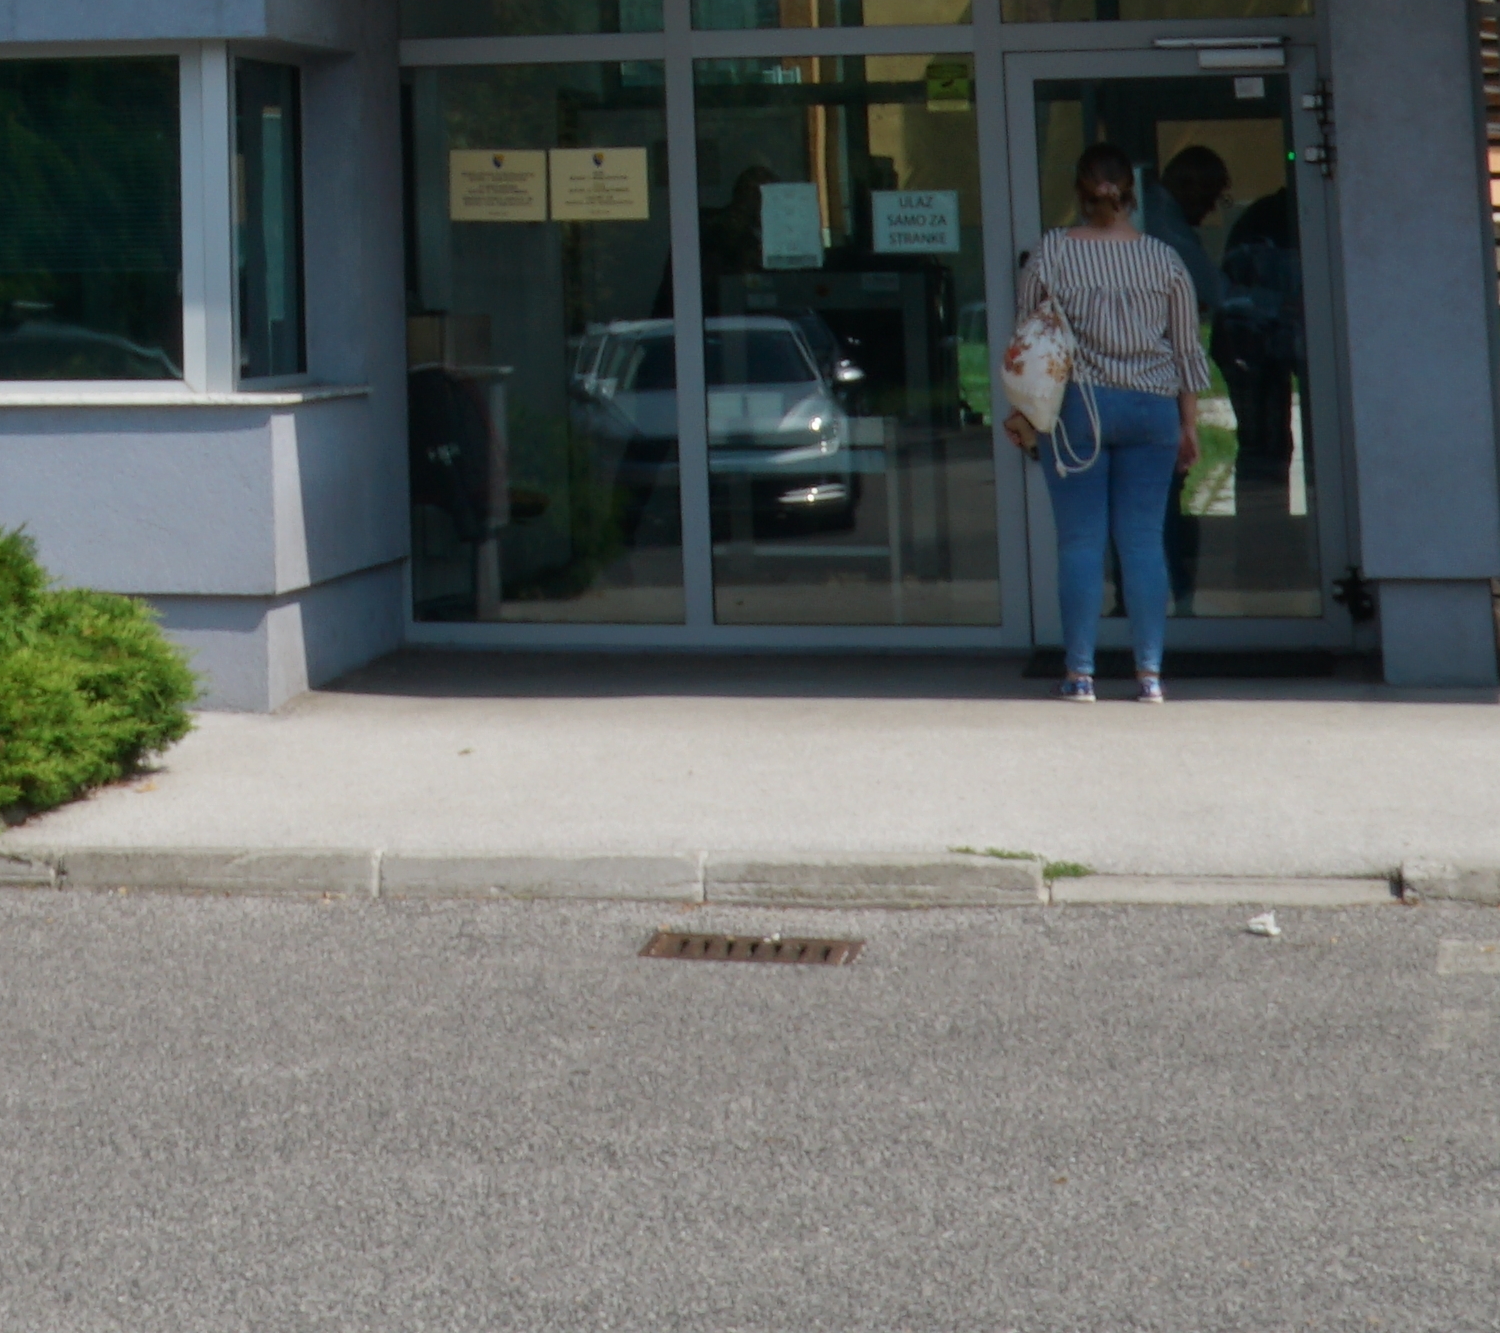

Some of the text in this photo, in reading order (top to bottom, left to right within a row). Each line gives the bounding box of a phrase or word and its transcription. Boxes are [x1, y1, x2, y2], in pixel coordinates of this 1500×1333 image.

[899, 195, 934, 209] ULAZ
[887, 214, 948, 227] SAMO ZA
[889, 232, 947, 245] STRANKE
